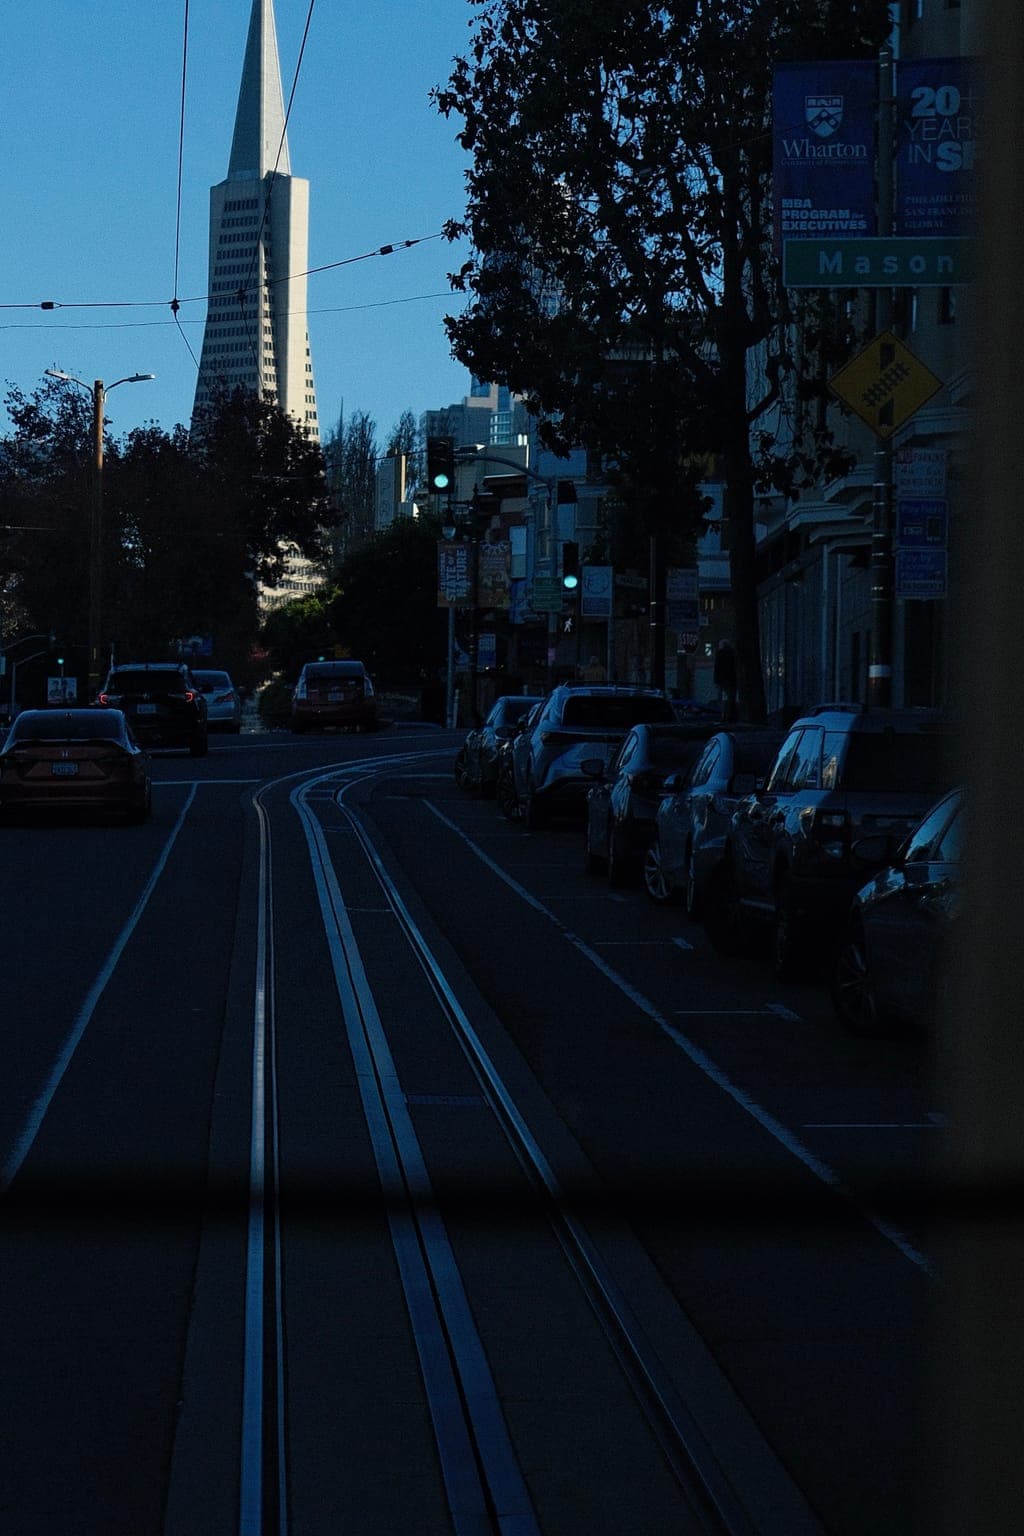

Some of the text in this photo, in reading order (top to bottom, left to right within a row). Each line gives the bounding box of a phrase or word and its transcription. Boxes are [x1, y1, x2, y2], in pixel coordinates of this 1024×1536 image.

[782, 138, 868, 158] Wharton
[908, 144, 932, 164] IN
[781, 198, 813, 209] MBA
[781, 209, 851, 220] PROGRAM
[781, 220, 868, 231] EXECUTIVES
[817, 249, 955, 276] Mason
[446, 566, 457, 602] STATE
